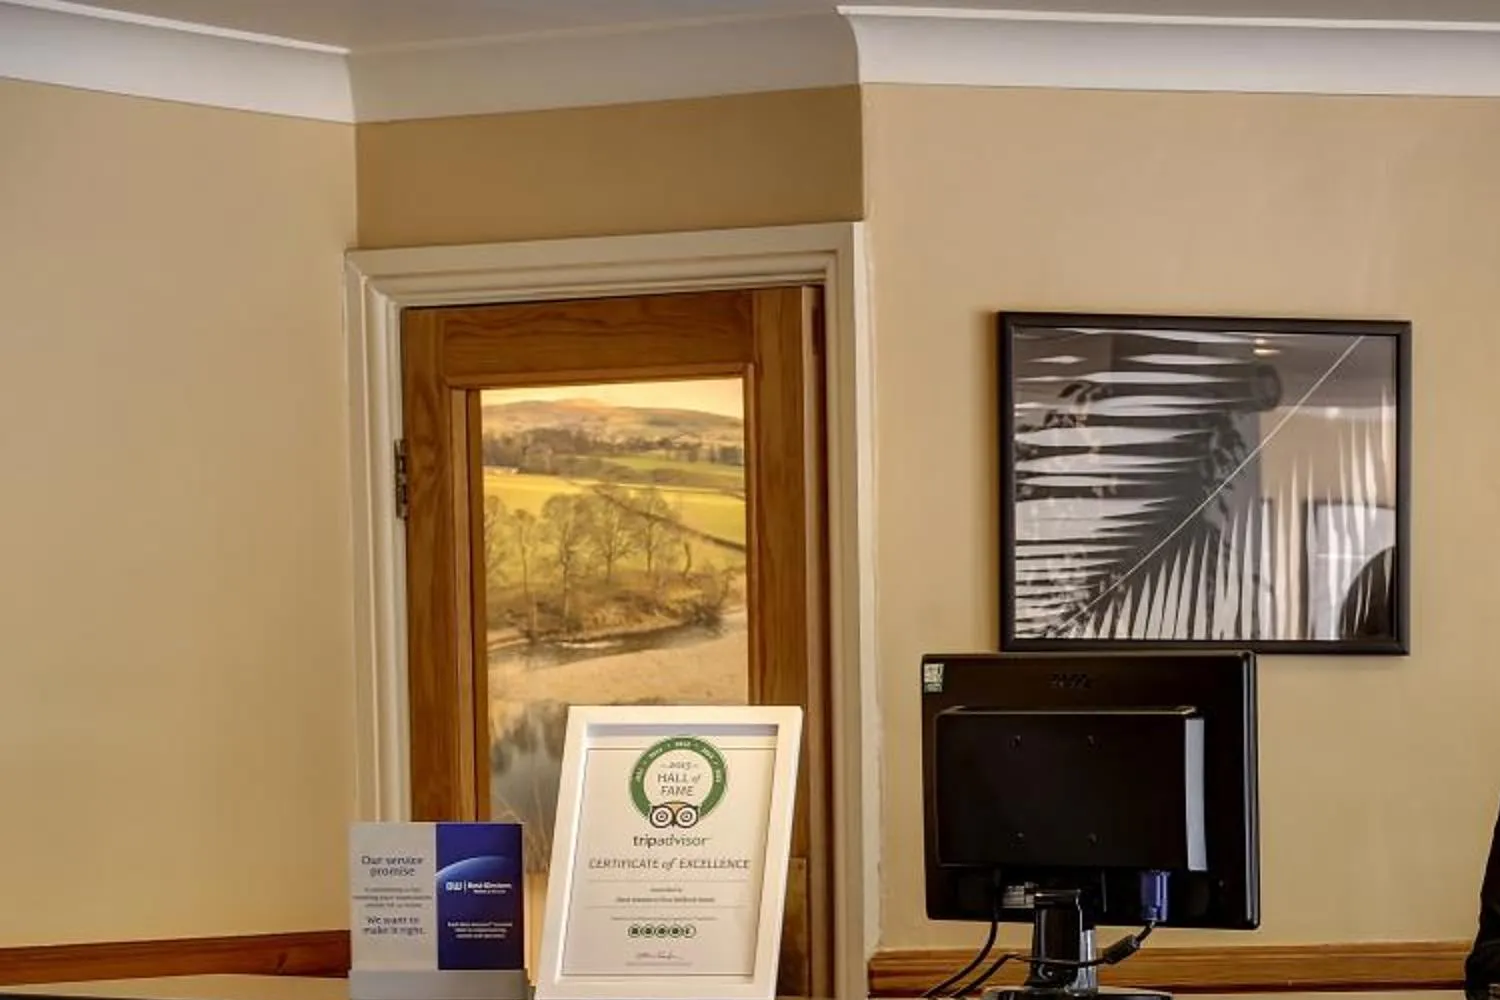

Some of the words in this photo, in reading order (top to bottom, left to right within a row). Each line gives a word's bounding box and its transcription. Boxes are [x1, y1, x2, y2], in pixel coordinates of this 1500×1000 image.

[657, 773, 688, 783] HALL
[691, 773, 702, 784] of
[660, 785, 696, 797] FAME
[632, 833, 706, 848] tripadvisor
[361, 856, 382, 865] Our
[385, 855, 424, 865] service
[588, 858, 659, 869] CERTIFICATE
[661, 857, 678, 870] of
[679, 858, 751, 869] EXCELLENCE
[369, 867, 416, 878] promise
[366, 916, 382, 925] We
[383, 916, 407, 925] want
[363, 926, 388, 935] make
